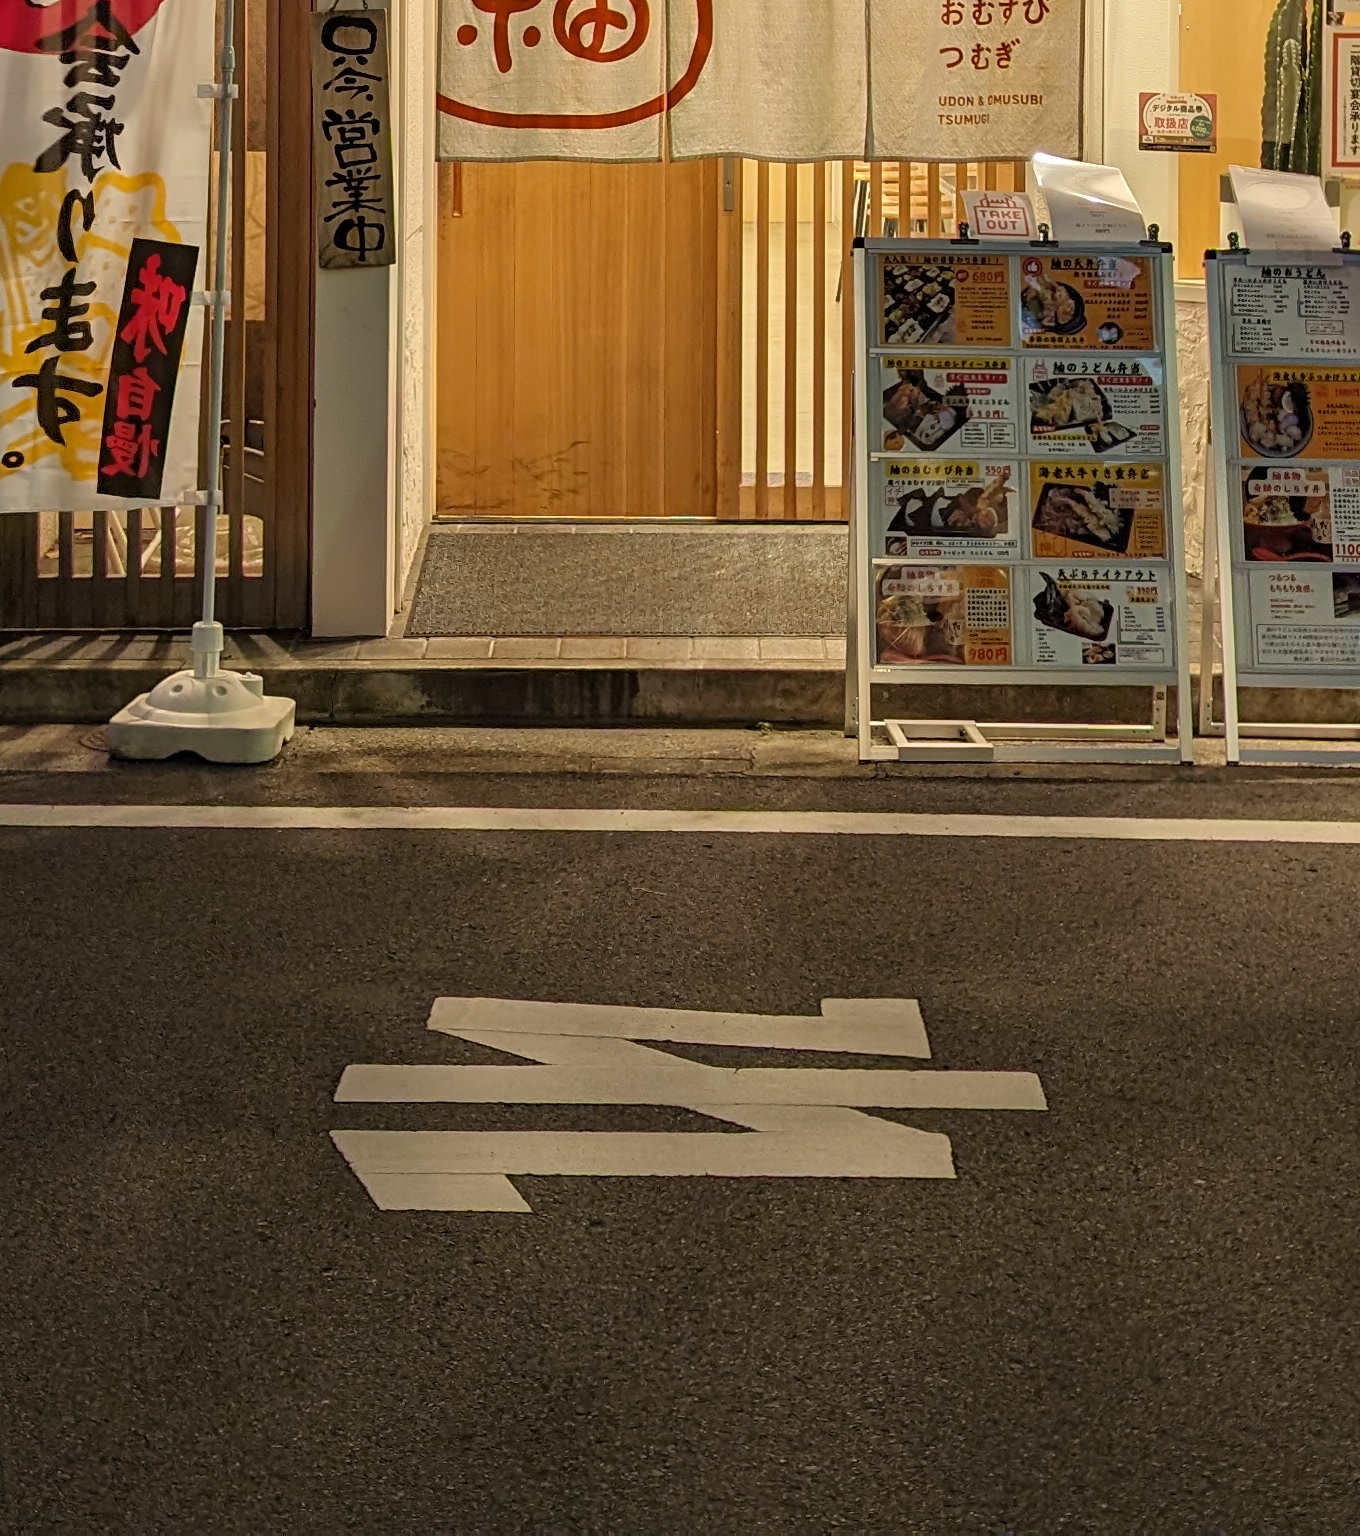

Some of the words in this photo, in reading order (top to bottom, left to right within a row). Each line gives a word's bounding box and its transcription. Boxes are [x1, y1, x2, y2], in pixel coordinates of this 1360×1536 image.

[938, 38, 1020, 71] つむぎ
[938, 95, 975, 107] UDON
[977, 95, 985, 107] &
[987, 94, 1043, 106] OMUSUBI
[1152, 104, 1203, 113] デジタル商品券
[937, 113, 990, 125] TSUMUGI
[1154, 117, 1188, 129] 取扱店
[320, 15, 385, 262] 只今営業中
[979, 209, 1023, 220] TAKE
[986, 220, 1018, 231] OUT
[972, 271, 1004, 282] 680円
[1053, 361, 1140, 374] 紬のうどん弁当
[889, 464, 974, 476] 紬のおむすび弁当
[1272, 470, 1302, 481] 紬名物
[1253, 483, 1321, 494] 奇跡のしらす丼
[1057, 568, 1156, 580] 天ぷらテイクアウト
[1268, 574, 1297, 582] つるつる
[968, 647, 1008, 662] 980円
